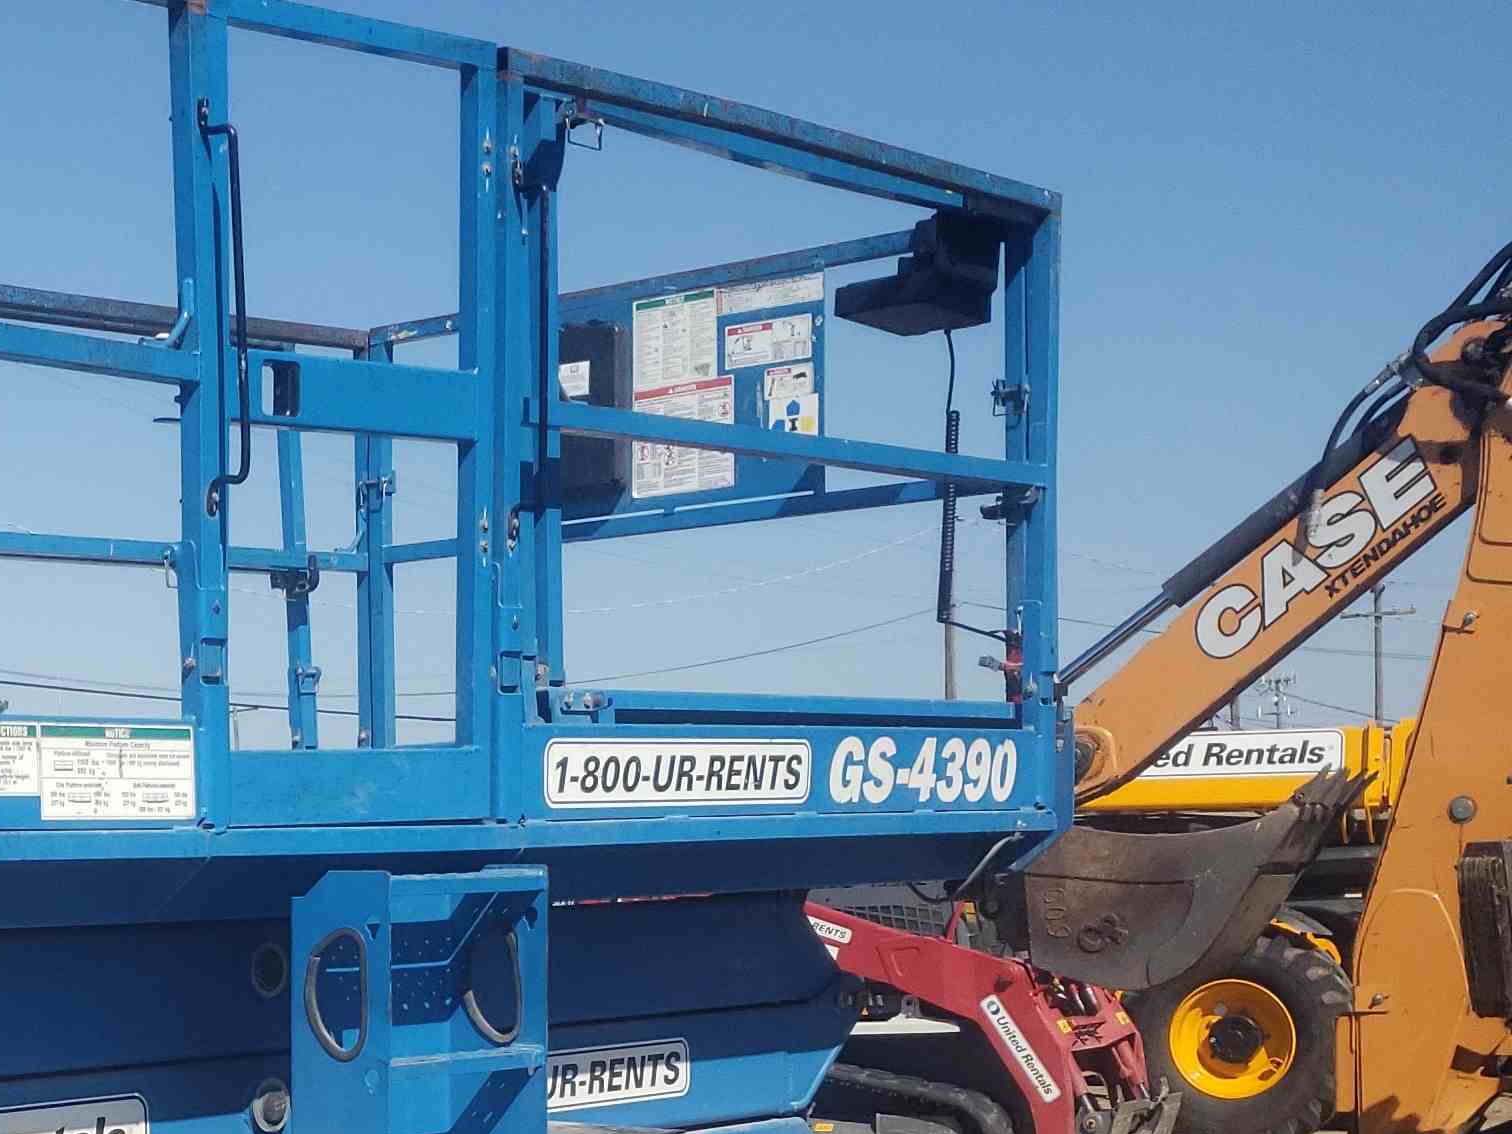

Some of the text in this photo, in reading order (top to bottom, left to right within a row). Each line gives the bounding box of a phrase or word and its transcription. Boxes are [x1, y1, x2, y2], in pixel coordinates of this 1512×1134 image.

[1195, 435, 1437, 659] CASE
[1324, 492, 1447, 598] XTENDAHOE
[554, 754, 803, 793] 1-800-UR-RENTS
[829, 736, 1018, 804] GS-4390
[1202, 740, 1325, 766] Rentals
[996, 1016, 1053, 1095] United Rentals
